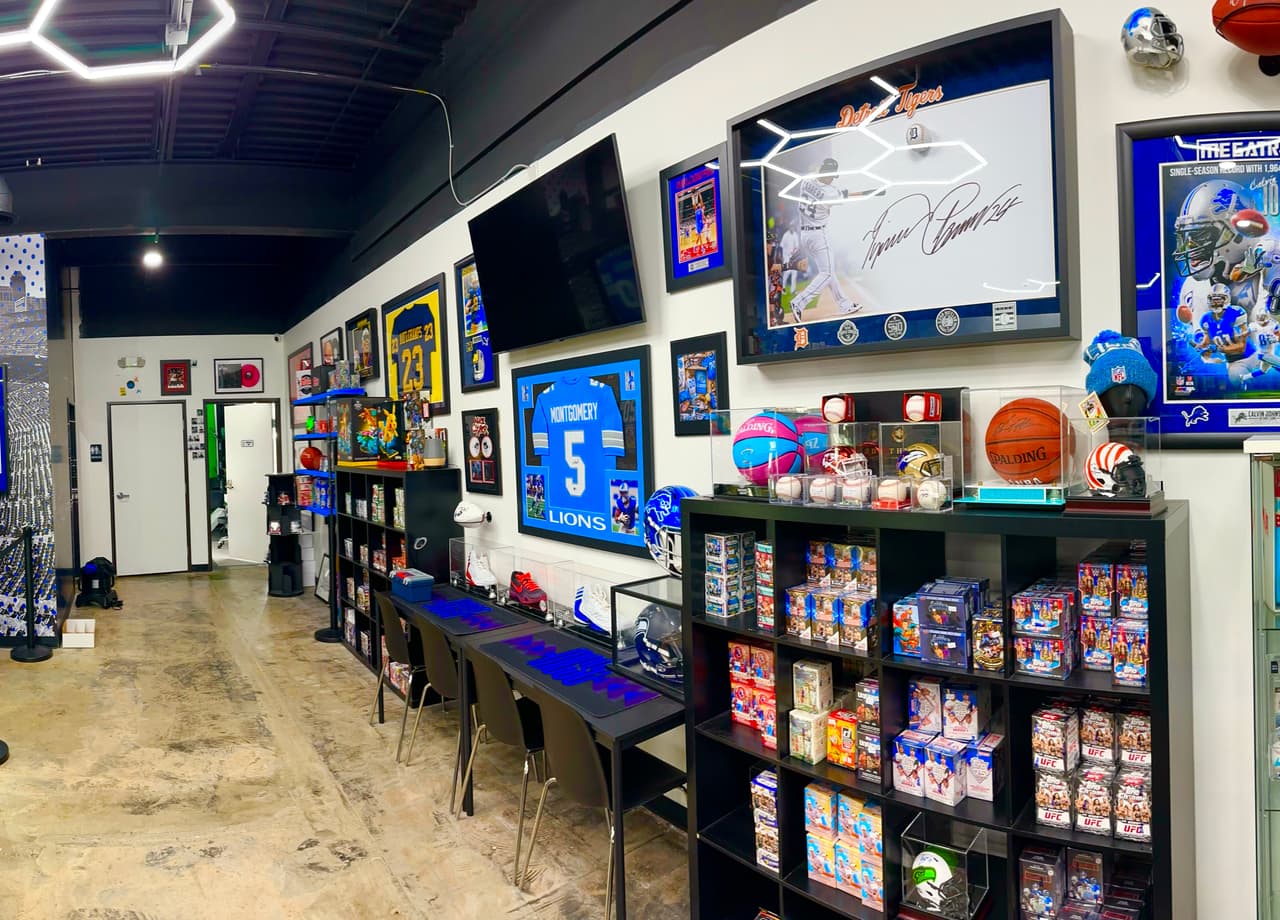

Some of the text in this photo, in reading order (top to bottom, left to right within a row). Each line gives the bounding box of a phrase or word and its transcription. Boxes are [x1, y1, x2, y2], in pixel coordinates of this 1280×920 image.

[895, 83, 944, 118] Tigers
[1170, 164, 1218, 176] SINGLE-SEASON
[1246, 164, 1263, 174] WITH
[401, 344, 424, 392] 23
[550, 402, 598, 423] MONTGOMERY
[564, 430, 586, 497] 5
[549, 510, 606, 530] LIONS
[1088, 748, 1104, 758] UFC
[1128, 754, 1146, 762] UFC
[1041, 758, 1056, 768] UFC
[1044, 812, 1062, 820] UFC
[1084, 818, 1102, 828] UFC
